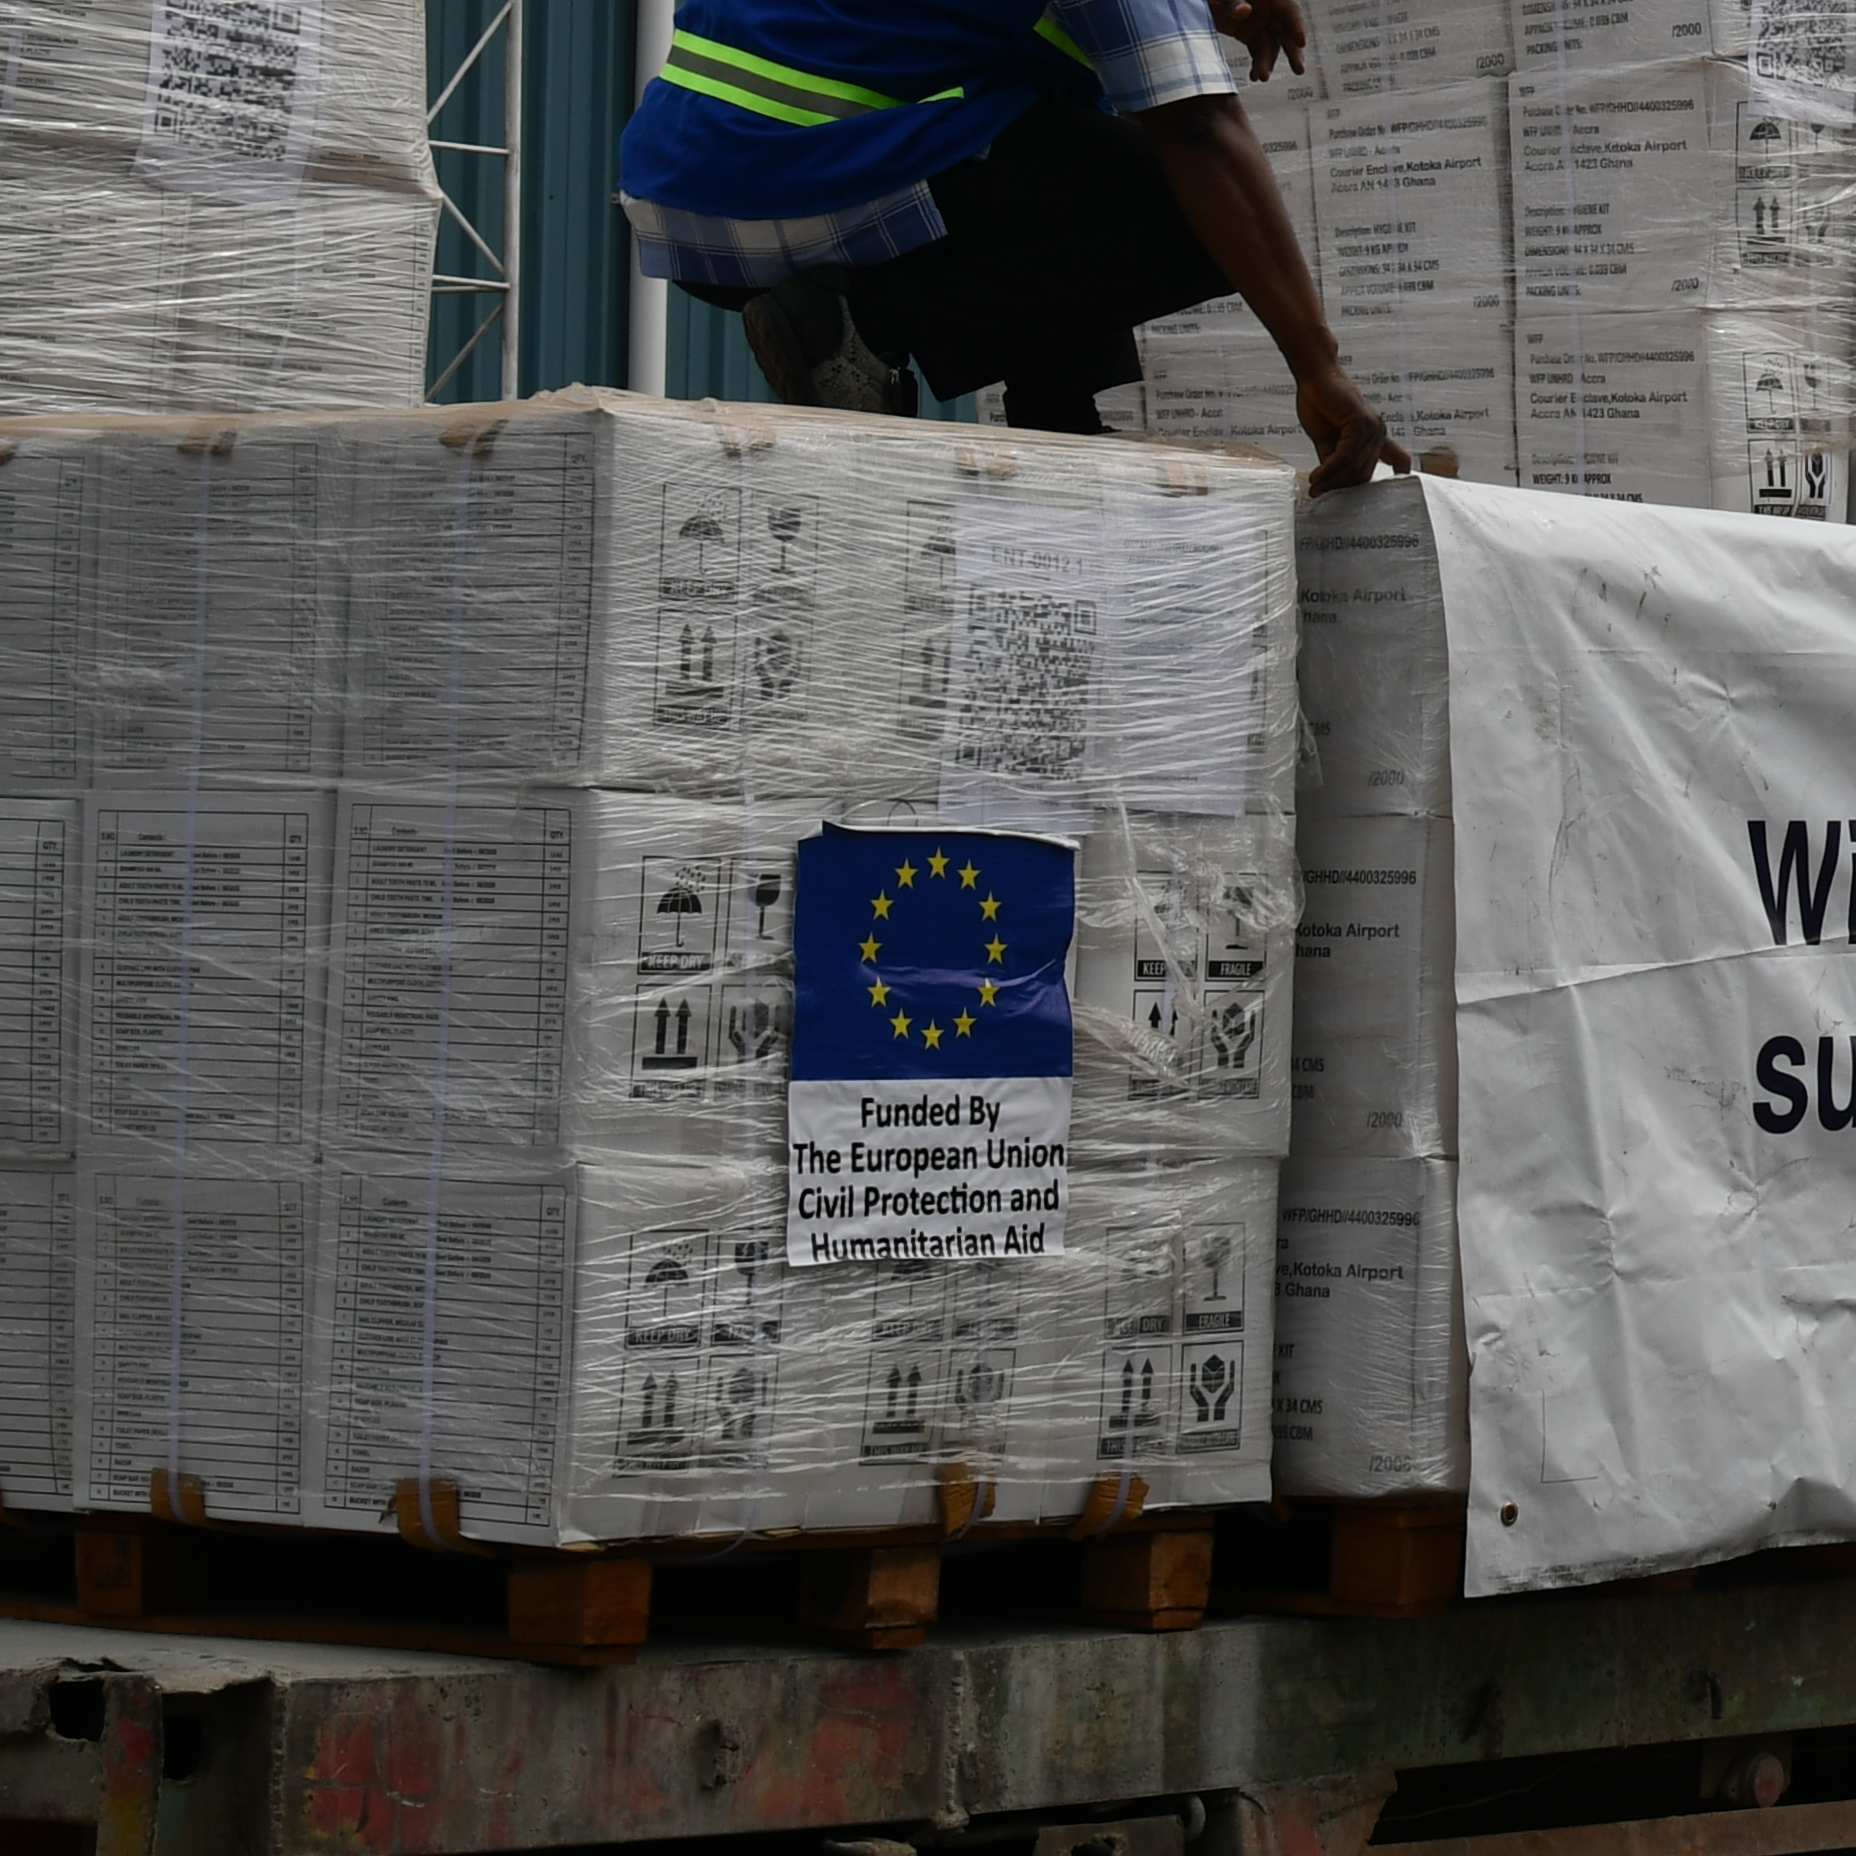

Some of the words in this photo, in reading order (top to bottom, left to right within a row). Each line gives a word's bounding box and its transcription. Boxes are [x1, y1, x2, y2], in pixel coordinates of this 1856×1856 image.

[1672, 22, 1702, 38] /2000
[1476, 53, 1505, 70] /2000
[1573, 125, 1599, 135] Accra
[1524, 145, 1561, 157] Courier
[1644, 139, 1687, 152] Airport
[1444, 156, 1482, 171] Airport
[1575, 158, 1598, 169] 1423
[1402, 176, 1436, 187] Ghana
[1671, 277, 1699, 292] /2000
[1473, 295, 1500, 308] /2000
[1527, 334, 1543, 344] WFP
[1529, 373, 1545, 384] WFP
[1581, 373, 1606, 384] Accra
[1530, 393, 1567, 404] Courier
[1570, 393, 1646, 406] Eclave,Kotoka
[1649, 391, 1688, 404] Airport
[1453, 408, 1490, 422] Airport
[1582, 408, 1605, 419] 1423
[1607, 407, 1640, 419] Ghana
[1267, 424, 1301, 438] Airport
[1533, 474, 1564, 485] WEIGHT:
[1584, 473, 1612, 485] APPROX
[1303, 609, 1337, 624] hana
[1346, 922, 1400, 941] Airport
[1295, 944, 1331, 958] hana
[648, 953, 678, 968] KEEP
[679, 954, 703, 970] DRY
[1143, 961, 1166, 974] KEEP
[1220, 962, 1252, 976] FRAGILE
[861, 1094, 960, 1128] Funded
[969, 1096, 1001, 1132] By
[793, 1141, 841, 1174] The
[851, 1141, 978, 1178] European
[987, 1136, 1065, 1169] Union
[799, 1185, 854, 1219] Civil
[864, 1182, 1001, 1217] Protection
[1011, 1179, 1059, 1211] and
[811, 1226, 995, 1262] Humanitarian
[1004, 1222, 1045, 1255] Aid
[1346, 1264, 1404, 1282] Airport
[1285, 1282, 1330, 1298] Ghana
[1142, 1319, 1165, 1332] DRY
[1199, 1315, 1230, 1328] FRAGILE
[1278, 1344, 1294, 1358] KIT
[1300, 1399, 1323, 1414] CMS
